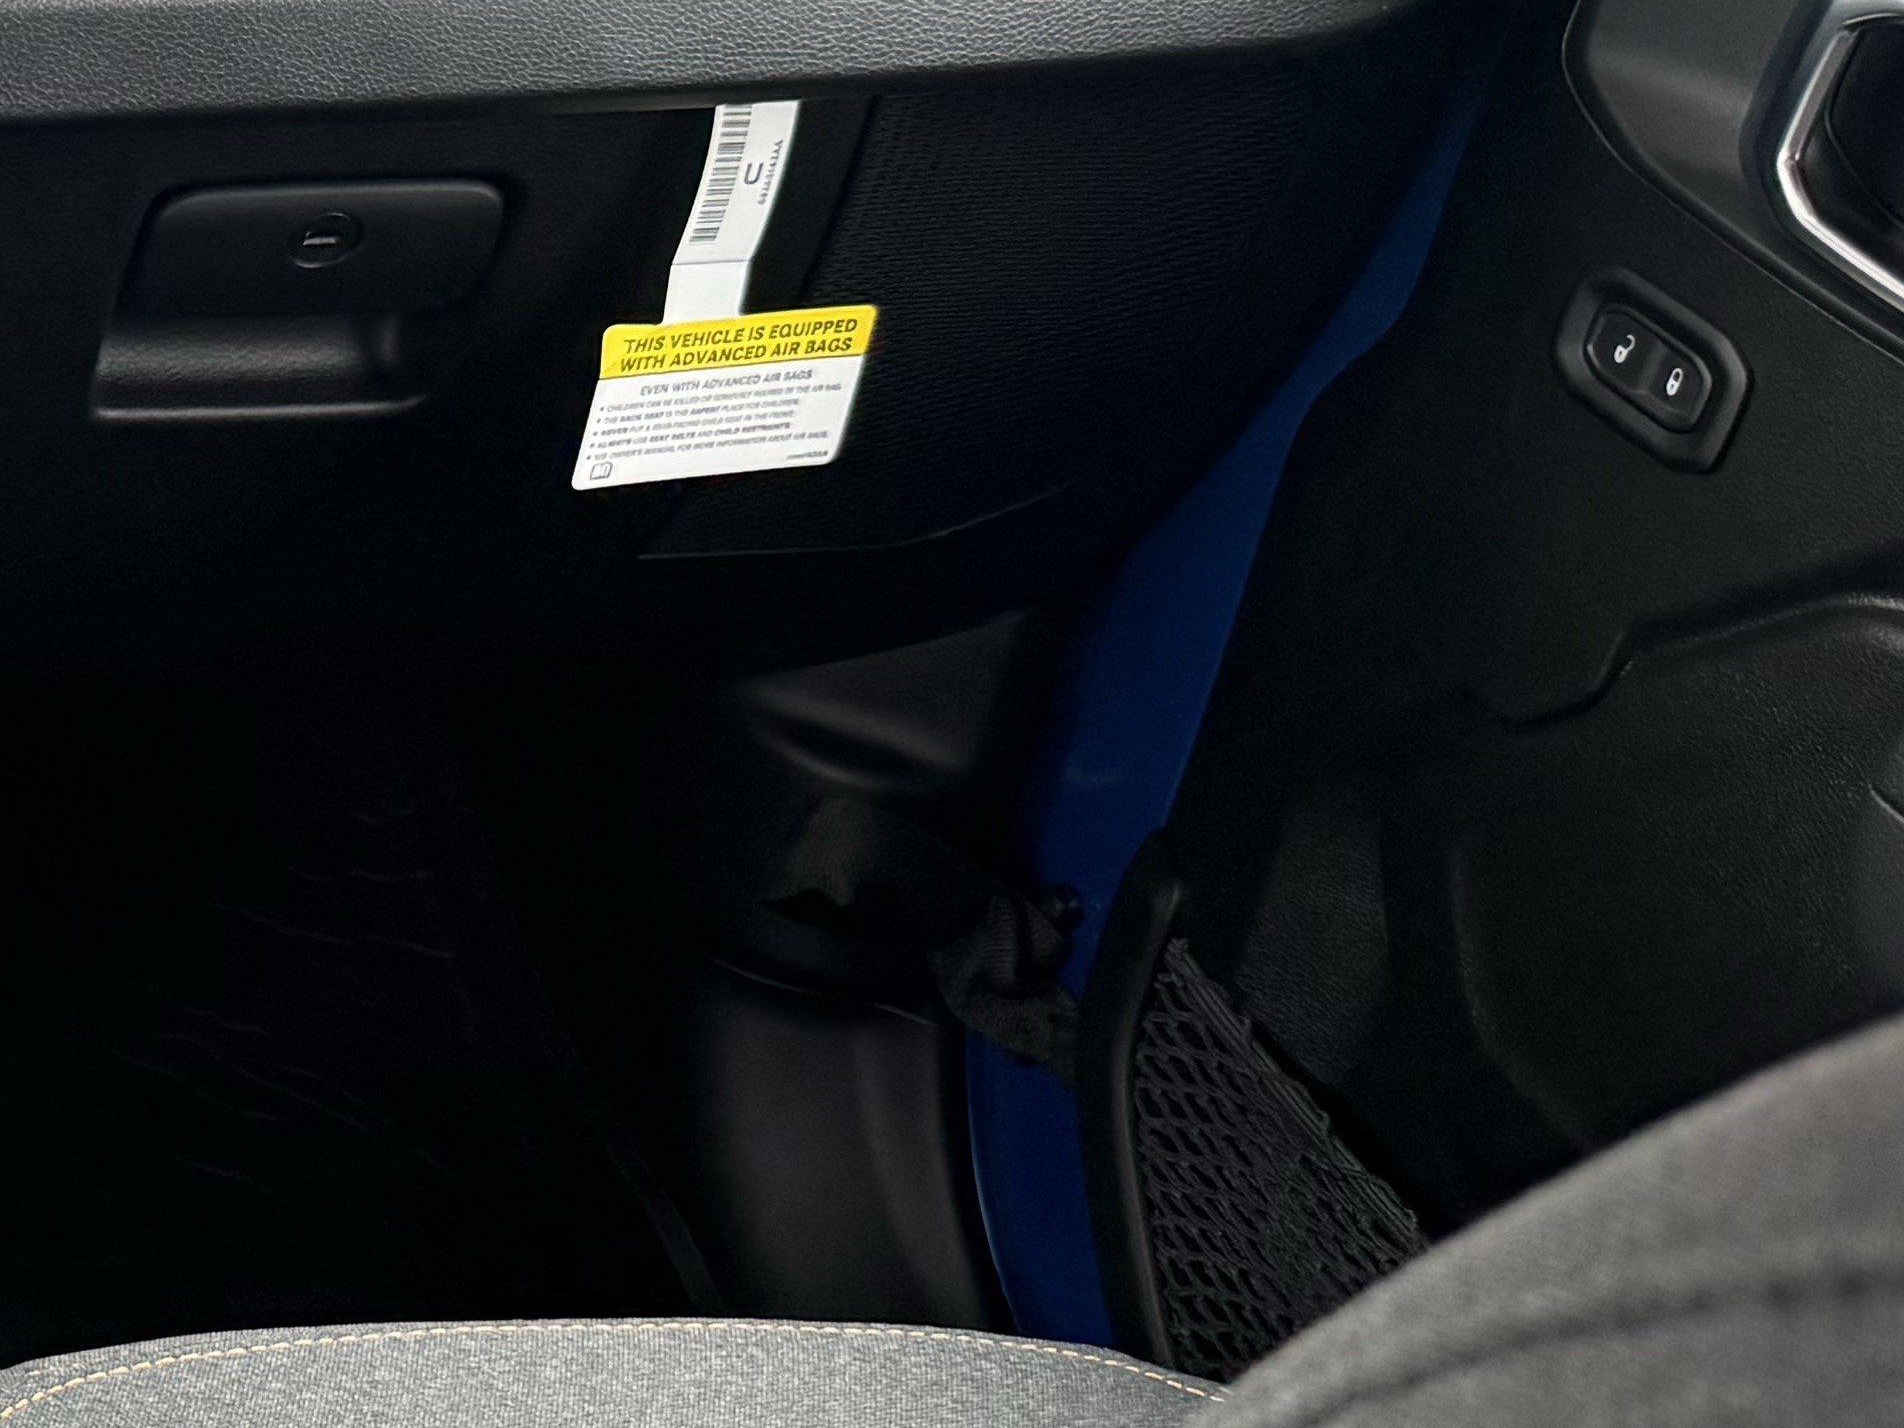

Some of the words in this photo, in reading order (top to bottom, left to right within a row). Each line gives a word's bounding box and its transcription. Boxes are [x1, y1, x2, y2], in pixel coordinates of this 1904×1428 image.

[624, 336, 665, 354] THIS
[670, 329, 744, 350] VEHICLE
[748, 326, 765, 342] IS
[769, 318, 858, 341] EQUIPPED
[620, 354, 665, 372] WITH
[669, 344, 766, 368] ADVANCED
[770, 342, 802, 357] AIR
[806, 337, 853, 355] BAGS
[640, 382, 669, 397] EVEN
[672, 379, 699, 393] WITH
[702, 373, 762, 391] ADVANCED
[765, 372, 781, 384] AIR
[783, 368, 813, 382] BAGS
